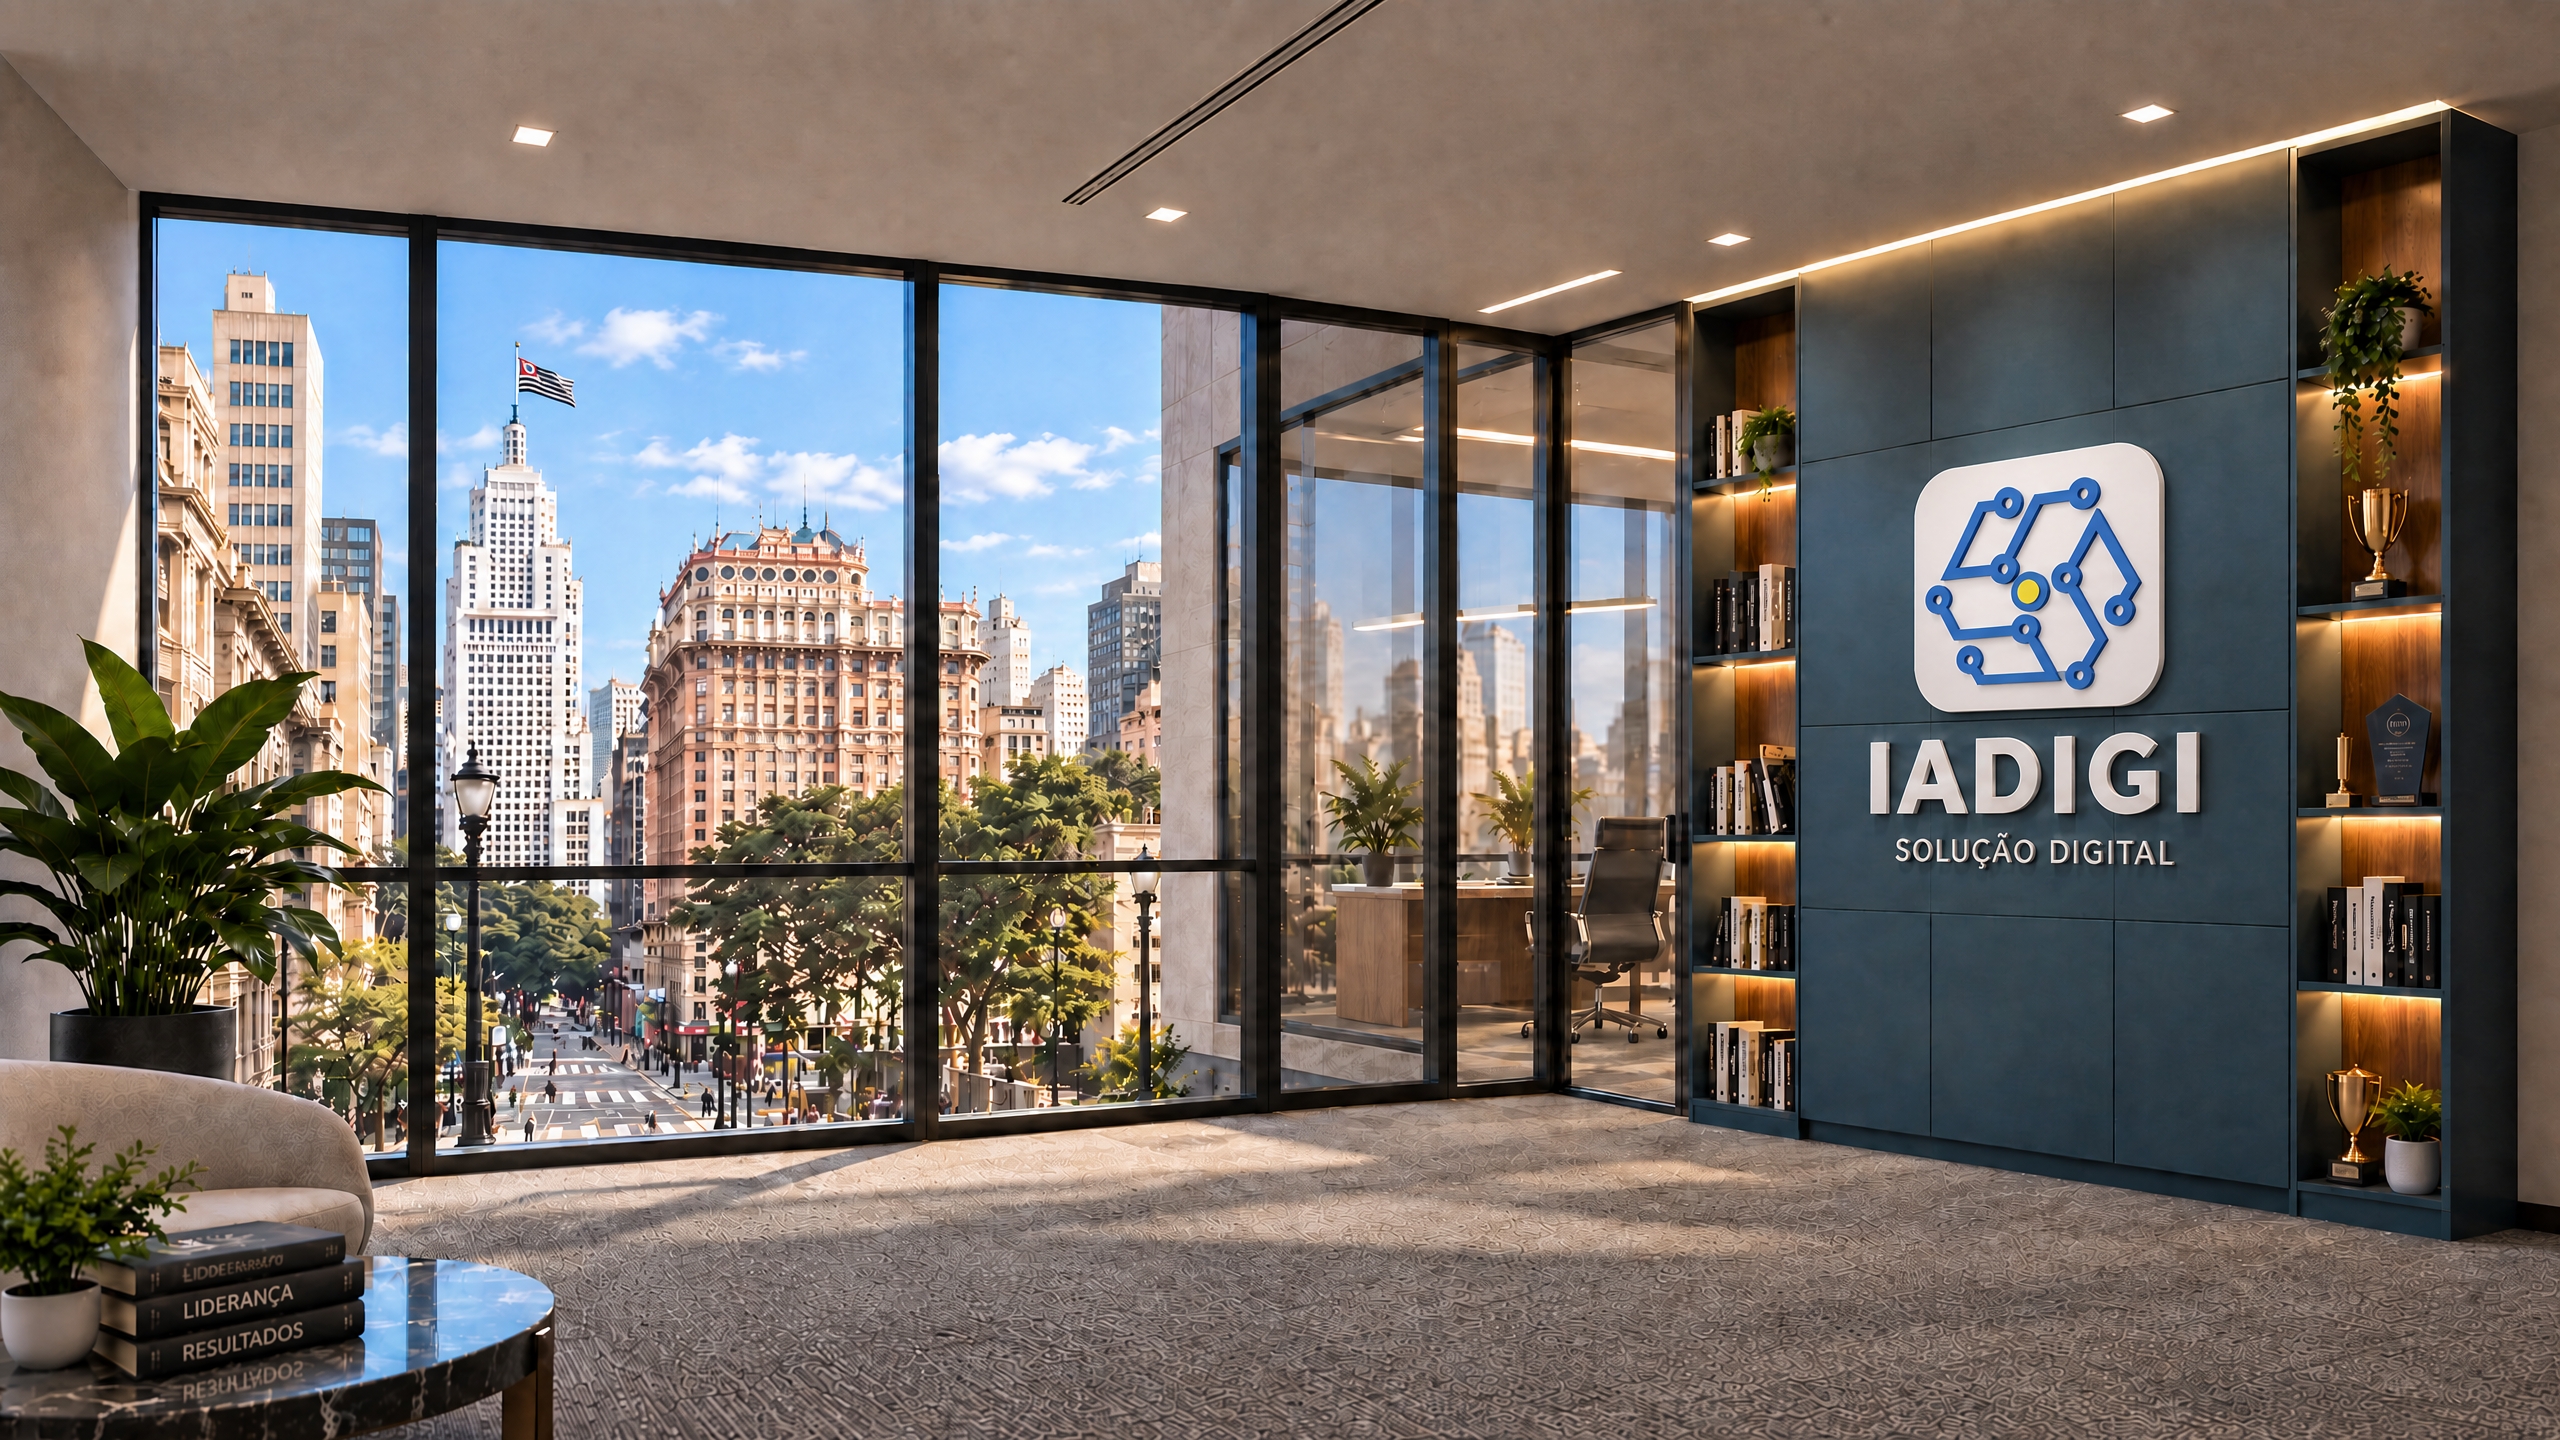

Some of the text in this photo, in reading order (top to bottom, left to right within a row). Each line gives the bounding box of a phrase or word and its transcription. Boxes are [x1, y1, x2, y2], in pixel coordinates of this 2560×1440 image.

[1870, 732, 2200, 815] IADIGI
[1895, 832, 2176, 870] SOLUÇÃO DIGITAL
[183, 1283, 294, 1320] LIDERANÇA
[183, 1321, 304, 1362] RESULTADOS
